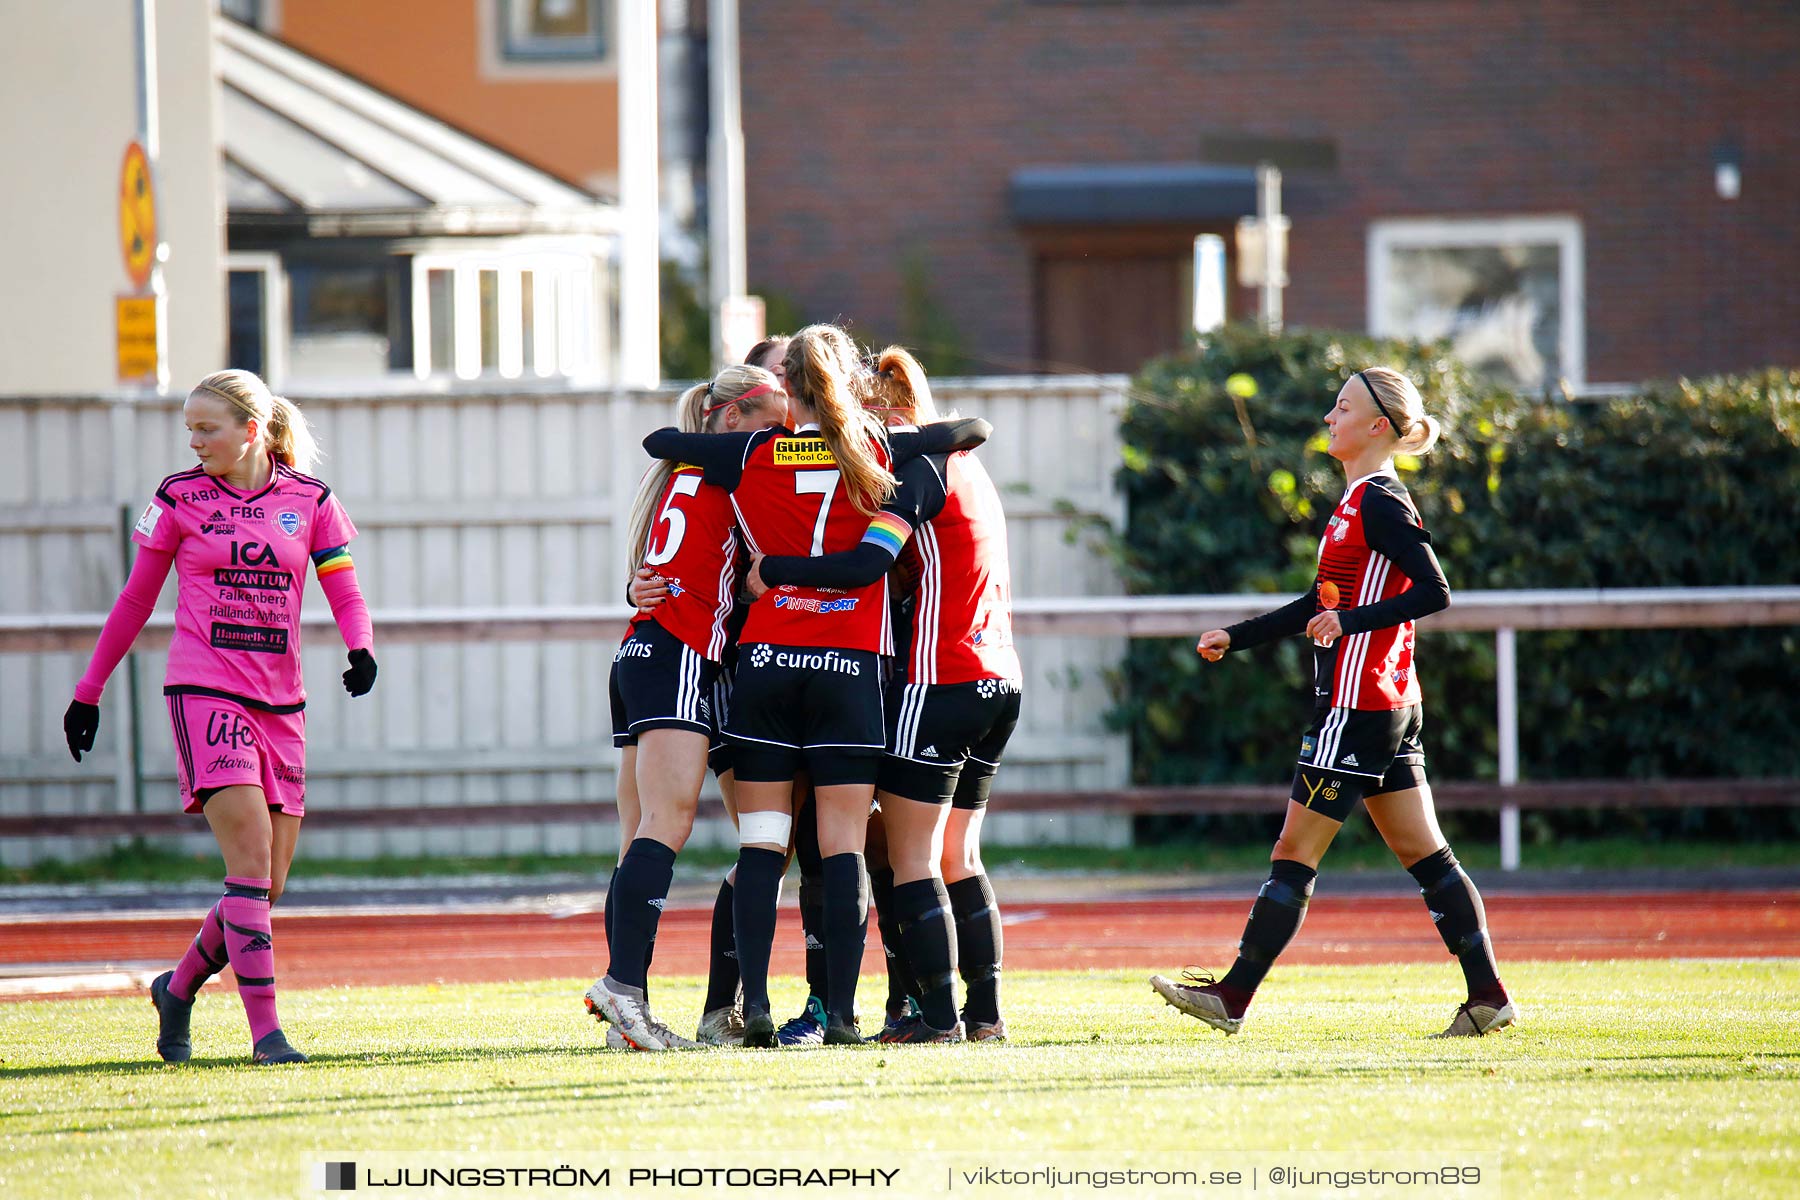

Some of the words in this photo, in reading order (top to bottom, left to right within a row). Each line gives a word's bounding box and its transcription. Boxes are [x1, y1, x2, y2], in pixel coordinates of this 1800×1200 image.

[795, 453, 814, 461] Tool
[230, 506, 265, 519] FBG
[795, 470, 840, 557] 7
[231, 541, 280, 568] ICA
[219, 571, 288, 587] KVANTUM
[219, 589, 287, 608] Falkenberg
[786, 597, 860, 613] INTERSPORT
[209, 605, 255, 620] Hallands
[776, 651, 860, 677] eurofins
